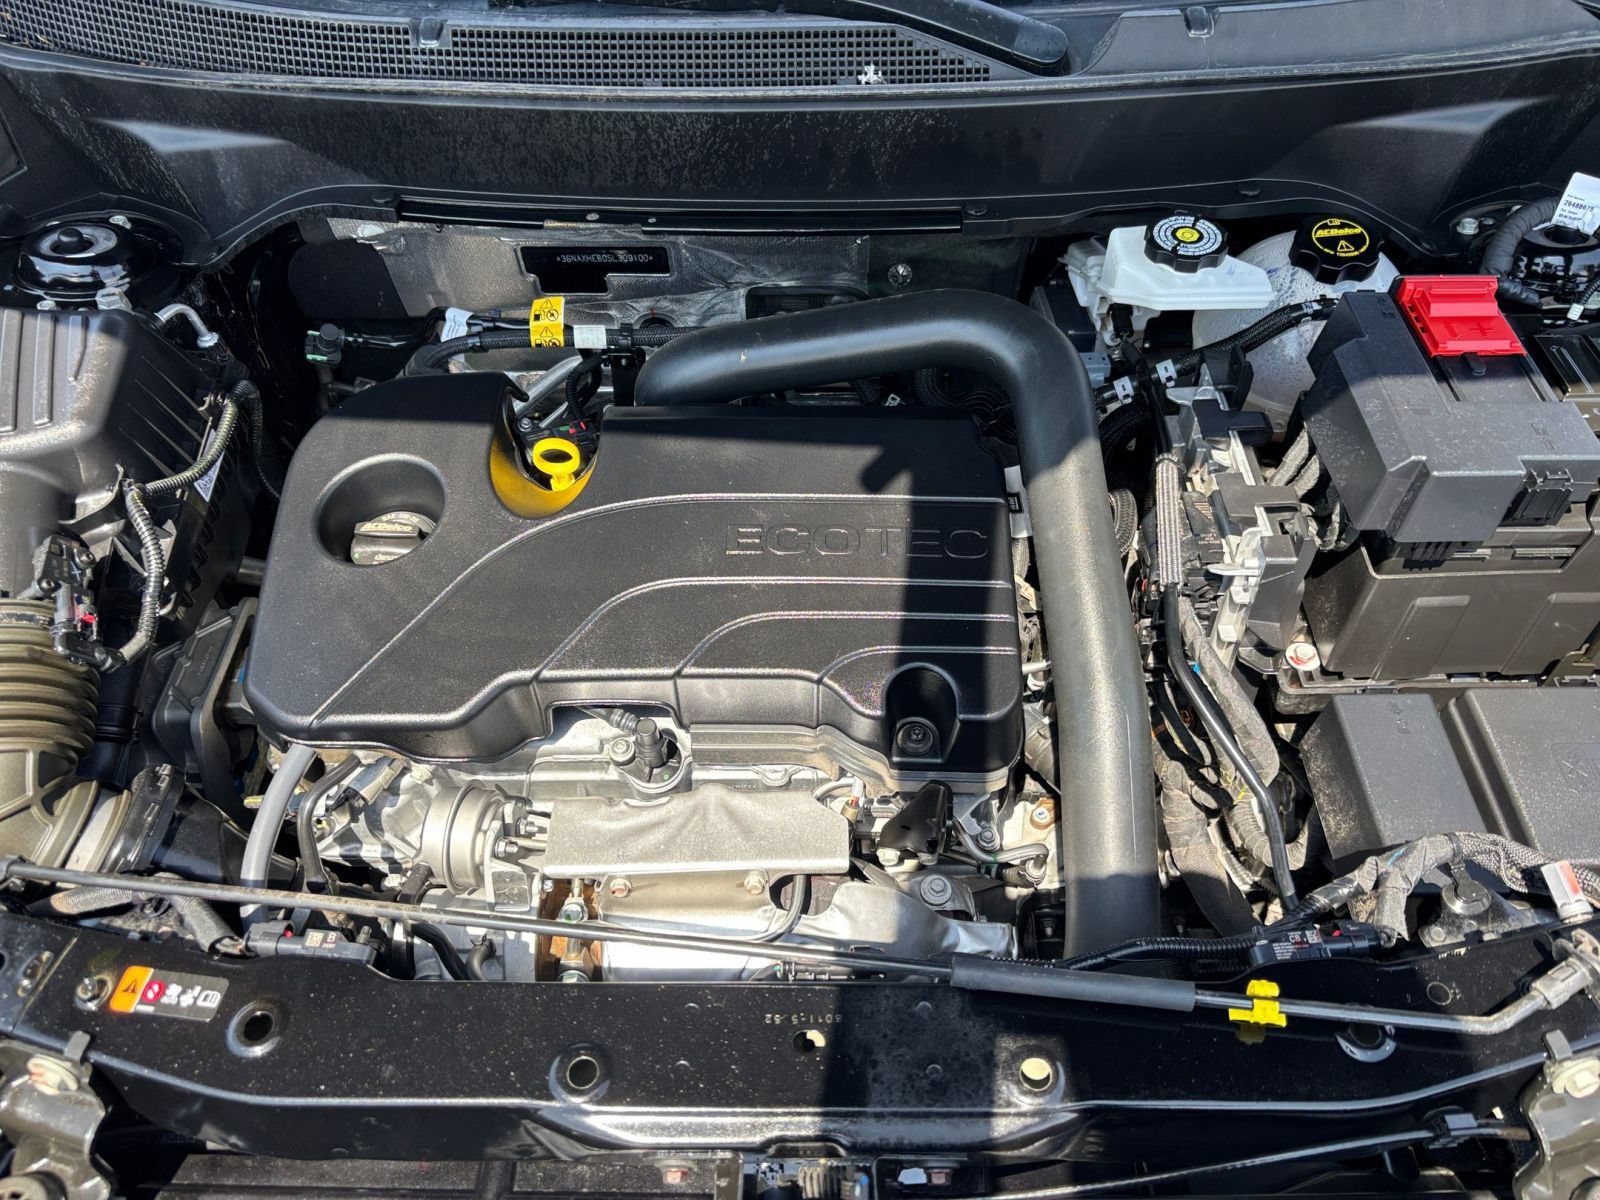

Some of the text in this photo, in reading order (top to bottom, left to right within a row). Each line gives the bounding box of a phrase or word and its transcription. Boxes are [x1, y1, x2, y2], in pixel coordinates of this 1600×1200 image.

[1315, 227, 1362, 238] ACDelco
[360, 522, 414, 532] ACDelco
[725, 523, 989, 559] ECOTEC
